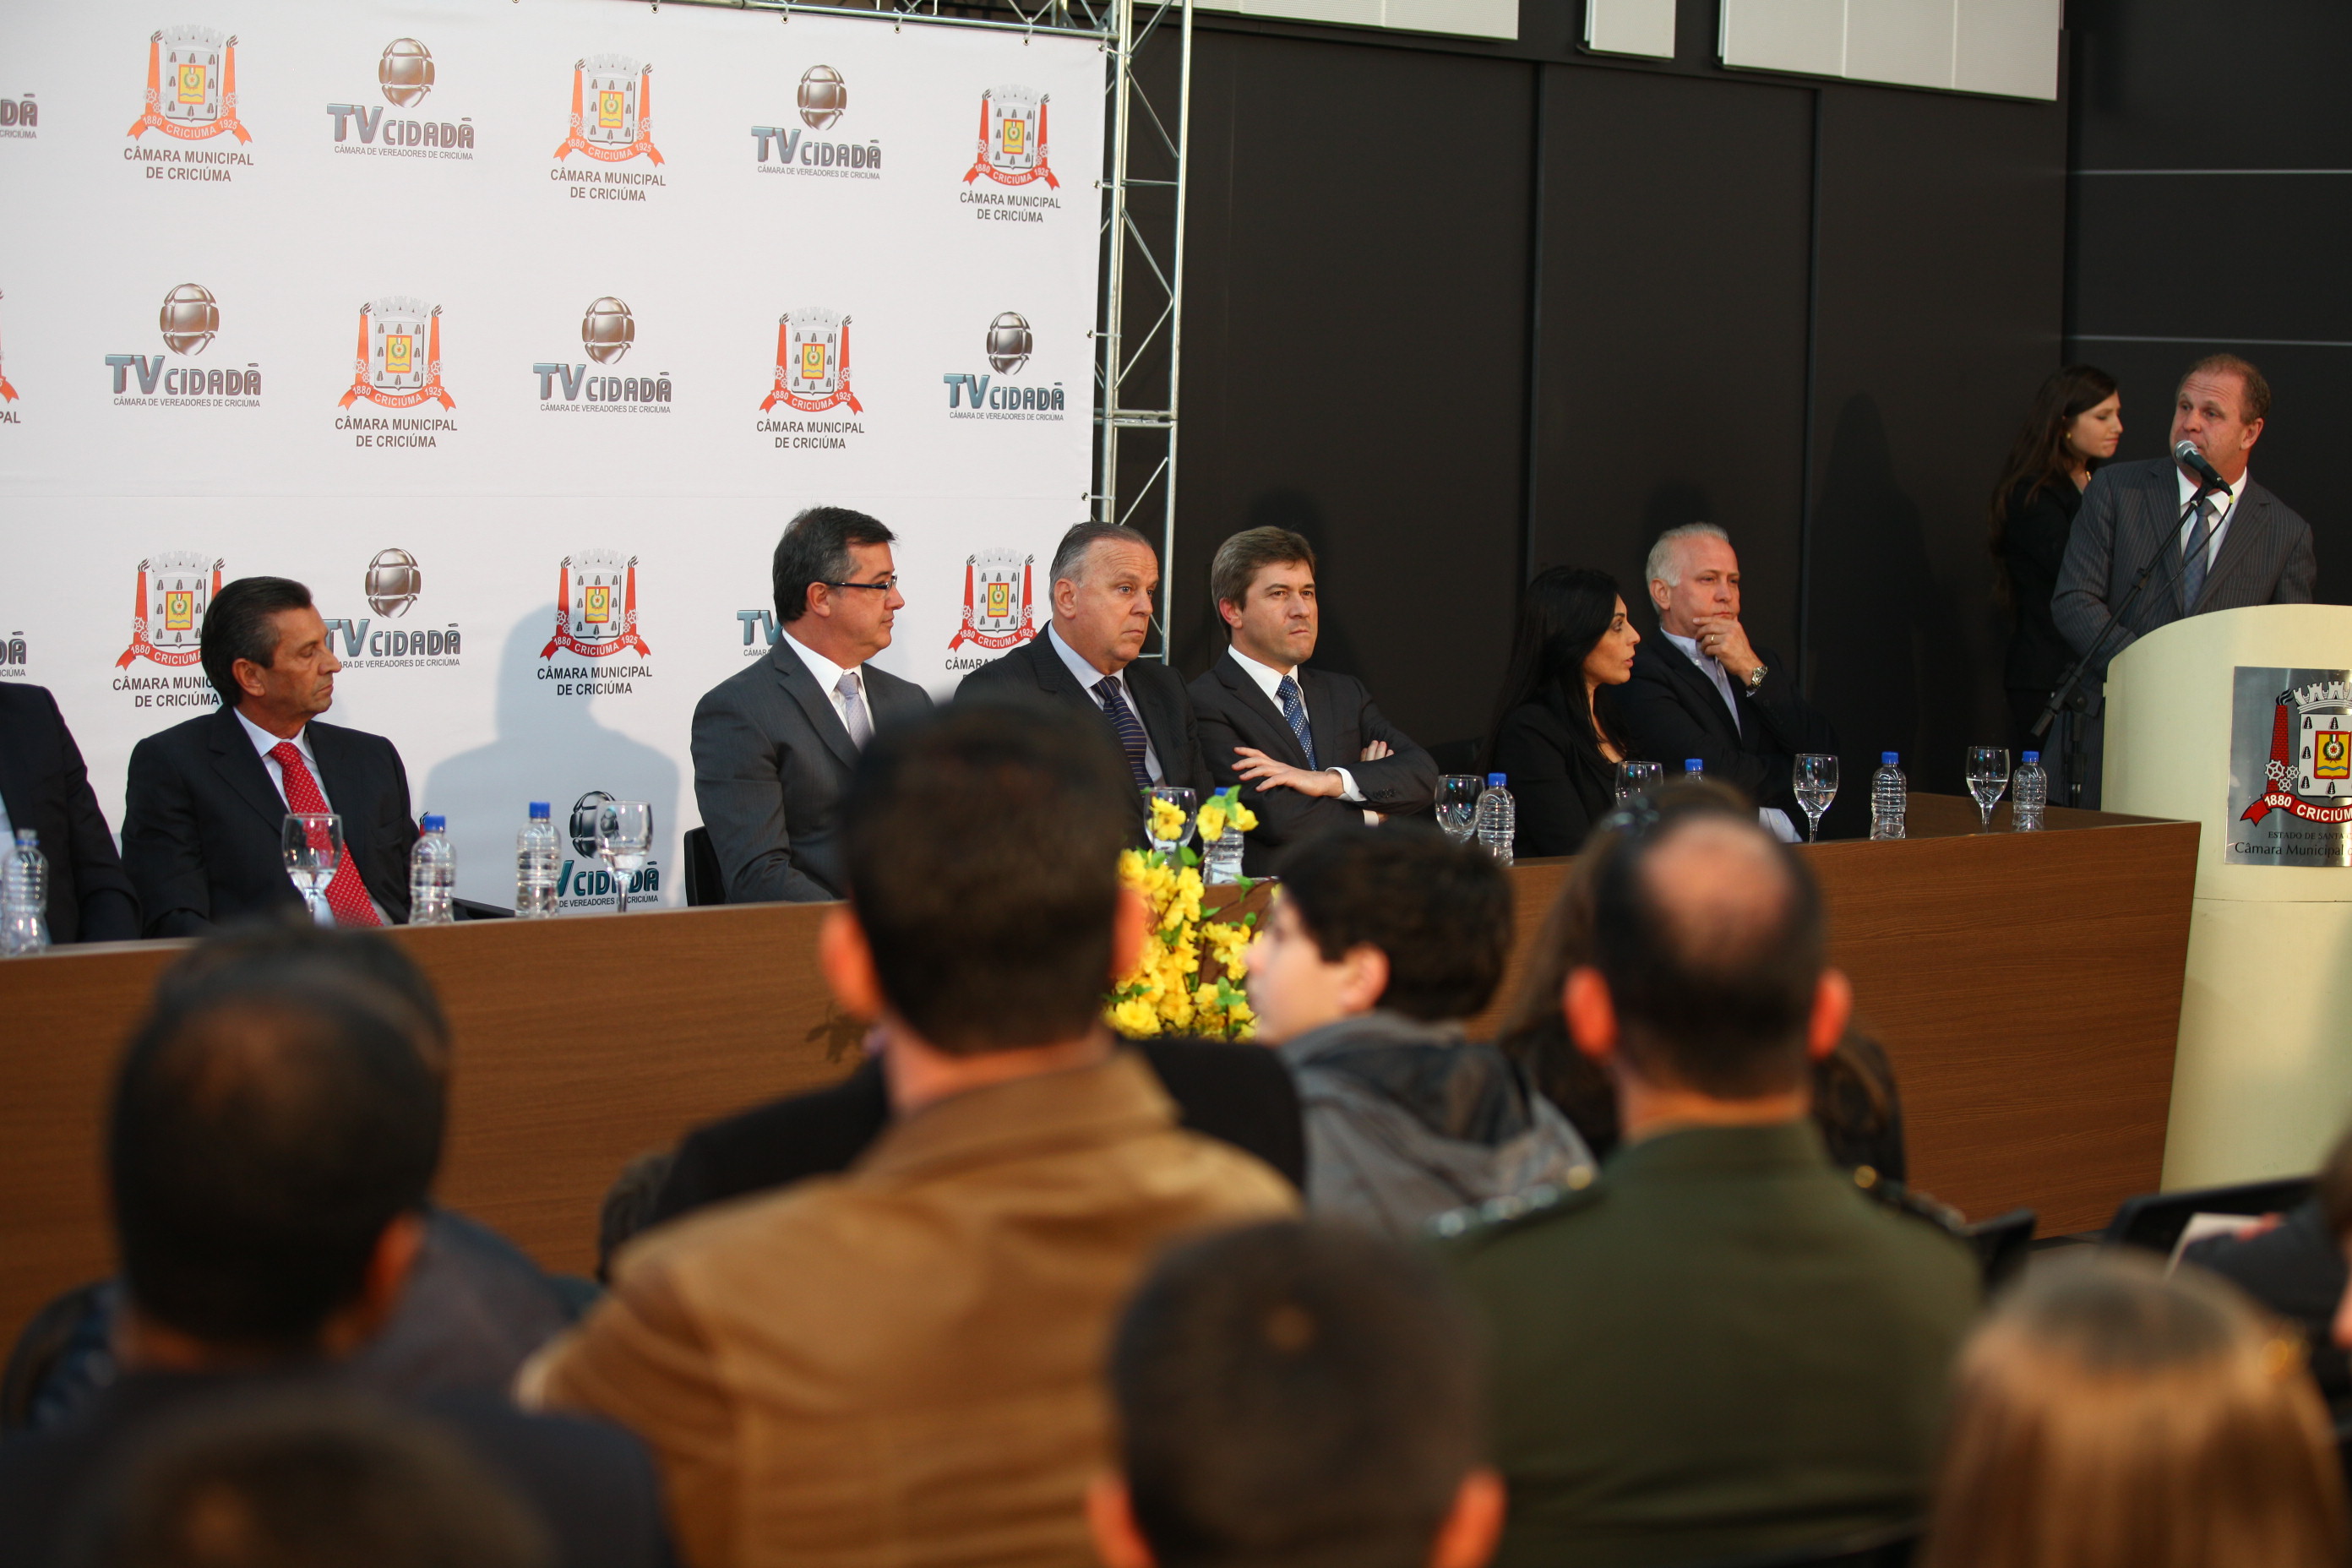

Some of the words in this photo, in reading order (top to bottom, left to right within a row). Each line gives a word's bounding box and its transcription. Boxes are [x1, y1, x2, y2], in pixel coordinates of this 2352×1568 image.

[143, 116, 162, 126] 1880
[166, 124, 216, 138] CRICIÚMA
[220, 120, 237, 129] 1925
[124, 146, 181, 162] CÂMARA
[185, 150, 253, 165] MUNICIPAL
[335, 144, 366, 155] CÂMARA
[378, 149, 427, 158] VEREADORES
[439, 150, 473, 160] CRICIÚMA
[568, 139, 585, 148] 1880
[588, 147, 633, 160] CRICIÚMA
[635, 143, 652, 152] 1925
[146, 166, 163, 179] DE
[168, 166, 231, 182] CRICIÚMA
[551, 167, 602, 182] CÂMARA
[605, 172, 666, 186] MUNICIPAL
[758, 165, 785, 174] CÂMARA
[797, 167, 839, 177] VEREADORES
[851, 171, 880, 179] CRICIÚMA
[975, 164, 990, 172] 1880
[993, 172, 1032, 184] CRICIÚMA
[1034, 167, 1048, 177] 1925
[571, 187, 585, 198] DE
[590, 187, 645, 201] CRICIÚMA
[961, 190, 1004, 205] CÂMARA
[1008, 195, 1060, 208] MUNICIPAL
[977, 209, 990, 219] DE
[994, 209, 1043, 222] CRICIÚMA
[114, 396, 146, 406] CÂMARA
[225, 398, 260, 407] CRICIÚMA
[352, 386, 371, 395] 1880
[374, 394, 422, 406] CRICIÚMA
[425, 387, 442, 396] 1925
[772, 390, 788, 400] 1880
[792, 398, 834, 410] CRICIÚMA
[836, 392, 852, 401] 1925
[541, 402, 569, 411] CÂMARA
[582, 405, 628, 413] VEREADORES
[640, 405, 670, 413] CRICIÚMA
[950, 411, 976, 419] CÂMARA
[335, 416, 389, 430] CÂMARA
[393, 419, 457, 431] MUNICIPAL
[757, 419, 804, 432] CÂMARA
[808, 422, 864, 433] MUNICIPAL
[357, 435, 373, 447] DE
[377, 433, 436, 447] CRICIÚMA
[776, 438, 789, 448] DE
[793, 435, 846, 449] CRICIÚMA
[554, 637, 571, 645] 1880
[574, 642, 619, 656] CRICIÚMA
[622, 635, 638, 645] 1925
[960, 629, 975, 638] 1880
[978, 635, 1017, 647] CRICIÚMA
[1019, 629, 1033, 637] 1925
[131, 645, 150, 655] 1880
[366, 659, 413, 667] VEREADORES
[426, 656, 460, 666] CRICIÚMA
[537, 666, 588, 679] CÂMARA
[591, 667, 652, 678] MUNICIPAL
[113, 676, 169, 690] CÂMARA
[173, 677, 212, 689] MUNIC
[558, 684, 572, 695] DE
[576, 681, 632, 695] CRICIÚMA
[135, 695, 152, 707] DE
[156, 691, 220, 706] CRICIÚMA
[2264, 795, 2291, 807] 1880
[2297, 804, 2352, 821] CRICIÚM
[2235, 842, 2282, 854] Câmara
[2286, 844, 2344, 858] Municipal
[574, 861, 659, 896] CIDDÃ
[569, 898, 614, 906] VEREADORES
[628, 894, 658, 903] CRICIÚMA
